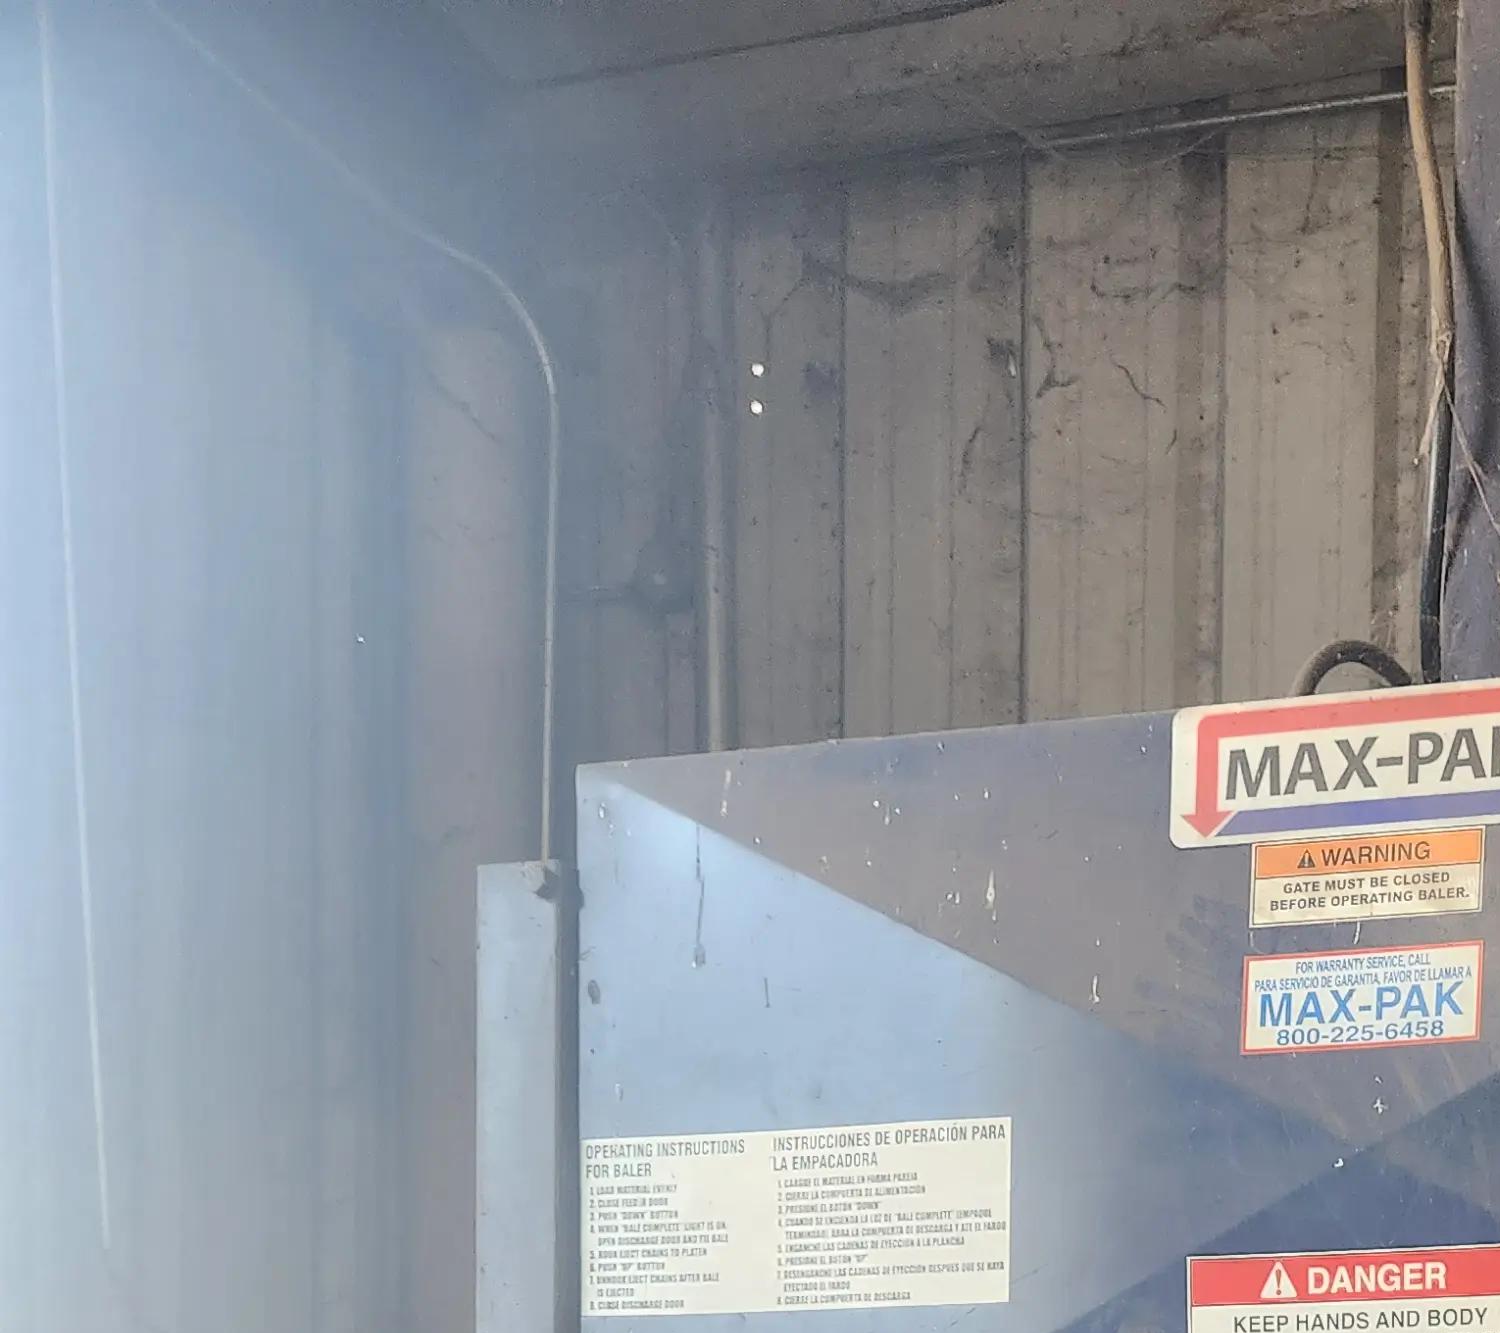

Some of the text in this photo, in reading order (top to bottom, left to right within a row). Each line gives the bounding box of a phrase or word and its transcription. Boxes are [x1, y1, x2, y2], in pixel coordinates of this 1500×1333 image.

[1322, 842, 1431, 865] WARNING
[1283, 871, 1449, 893] GATE MUST BE CLOSED
[1270, 886, 1469, 910] BEFORE OPERATING BALER.
[1295, 957, 1313, 974] FOR
[1315, 957, 1365, 971] WARRANTY
[1407, 953, 1431, 971] CALL
[1254, 979, 1277, 992] PARA
[1279, 976, 1318, 990] SERVICIO
[1320, 975, 1332, 988] DE
[1383, 969, 1411, 983] FAVOR
[1414, 968, 1425, 985] DE
[1427, 966, 1463, 983] LLAMAR
[1465, 965, 1472, 977] A
[1259, 981, 1463, 1027] MAX-PAK
[1277, 1021, 1445, 1046] 800-225-6458
[583, 1139, 744, 1159] OPERATING INSTRUCTIONS
[773, 1132, 869, 1150] INSTRUCCIONES
[874, 1130, 890, 1145] DE
[971, 1124, 1005, 1140] PARA
[585, 1162, 651, 1179] FOR BALER
[772, 1152, 877, 1171] LA EMPACADORA
[1307, 1262, 1447, 1295] DANGER
[1233, 1307, 1487, 1332] KEEP HANDS AND BODY
